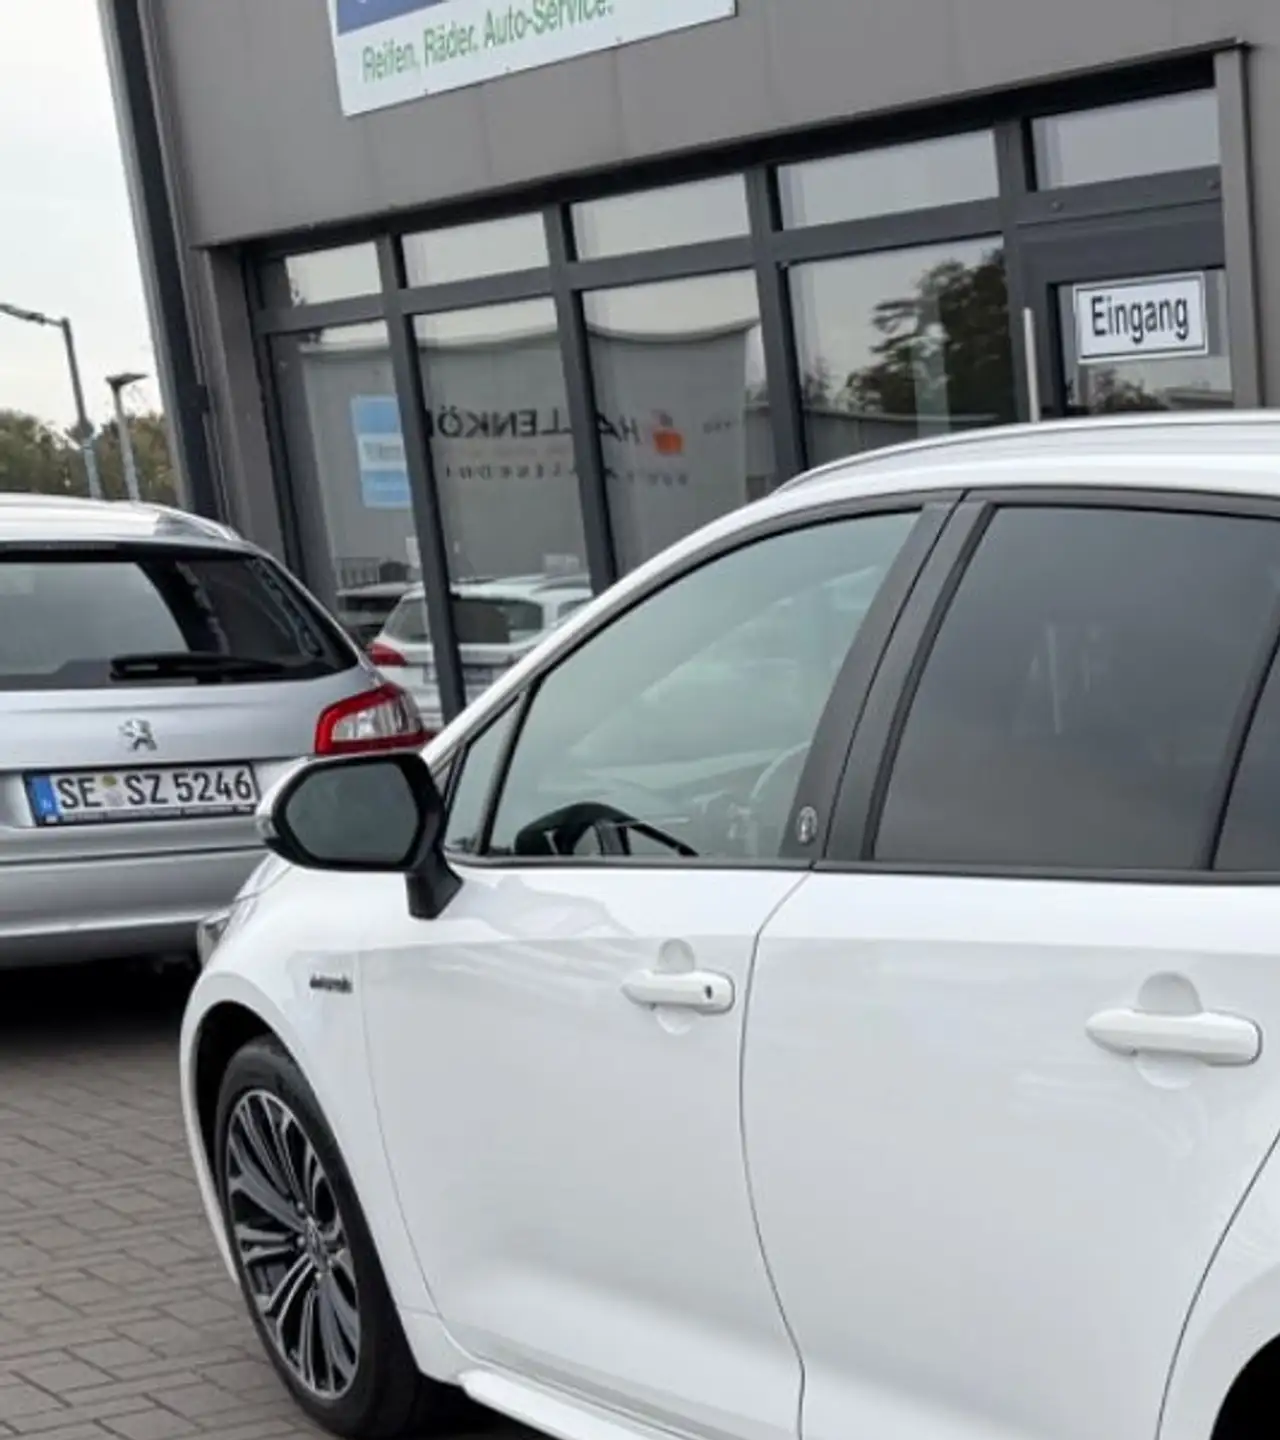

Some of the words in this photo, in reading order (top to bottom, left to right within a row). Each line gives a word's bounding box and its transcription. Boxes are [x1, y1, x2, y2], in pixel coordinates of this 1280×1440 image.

[1091, 296, 1189, 344] Eingang
[56, 777, 101, 809] SE
[123, 773, 169, 805] SZ
[172, 770, 251, 802] 5246
